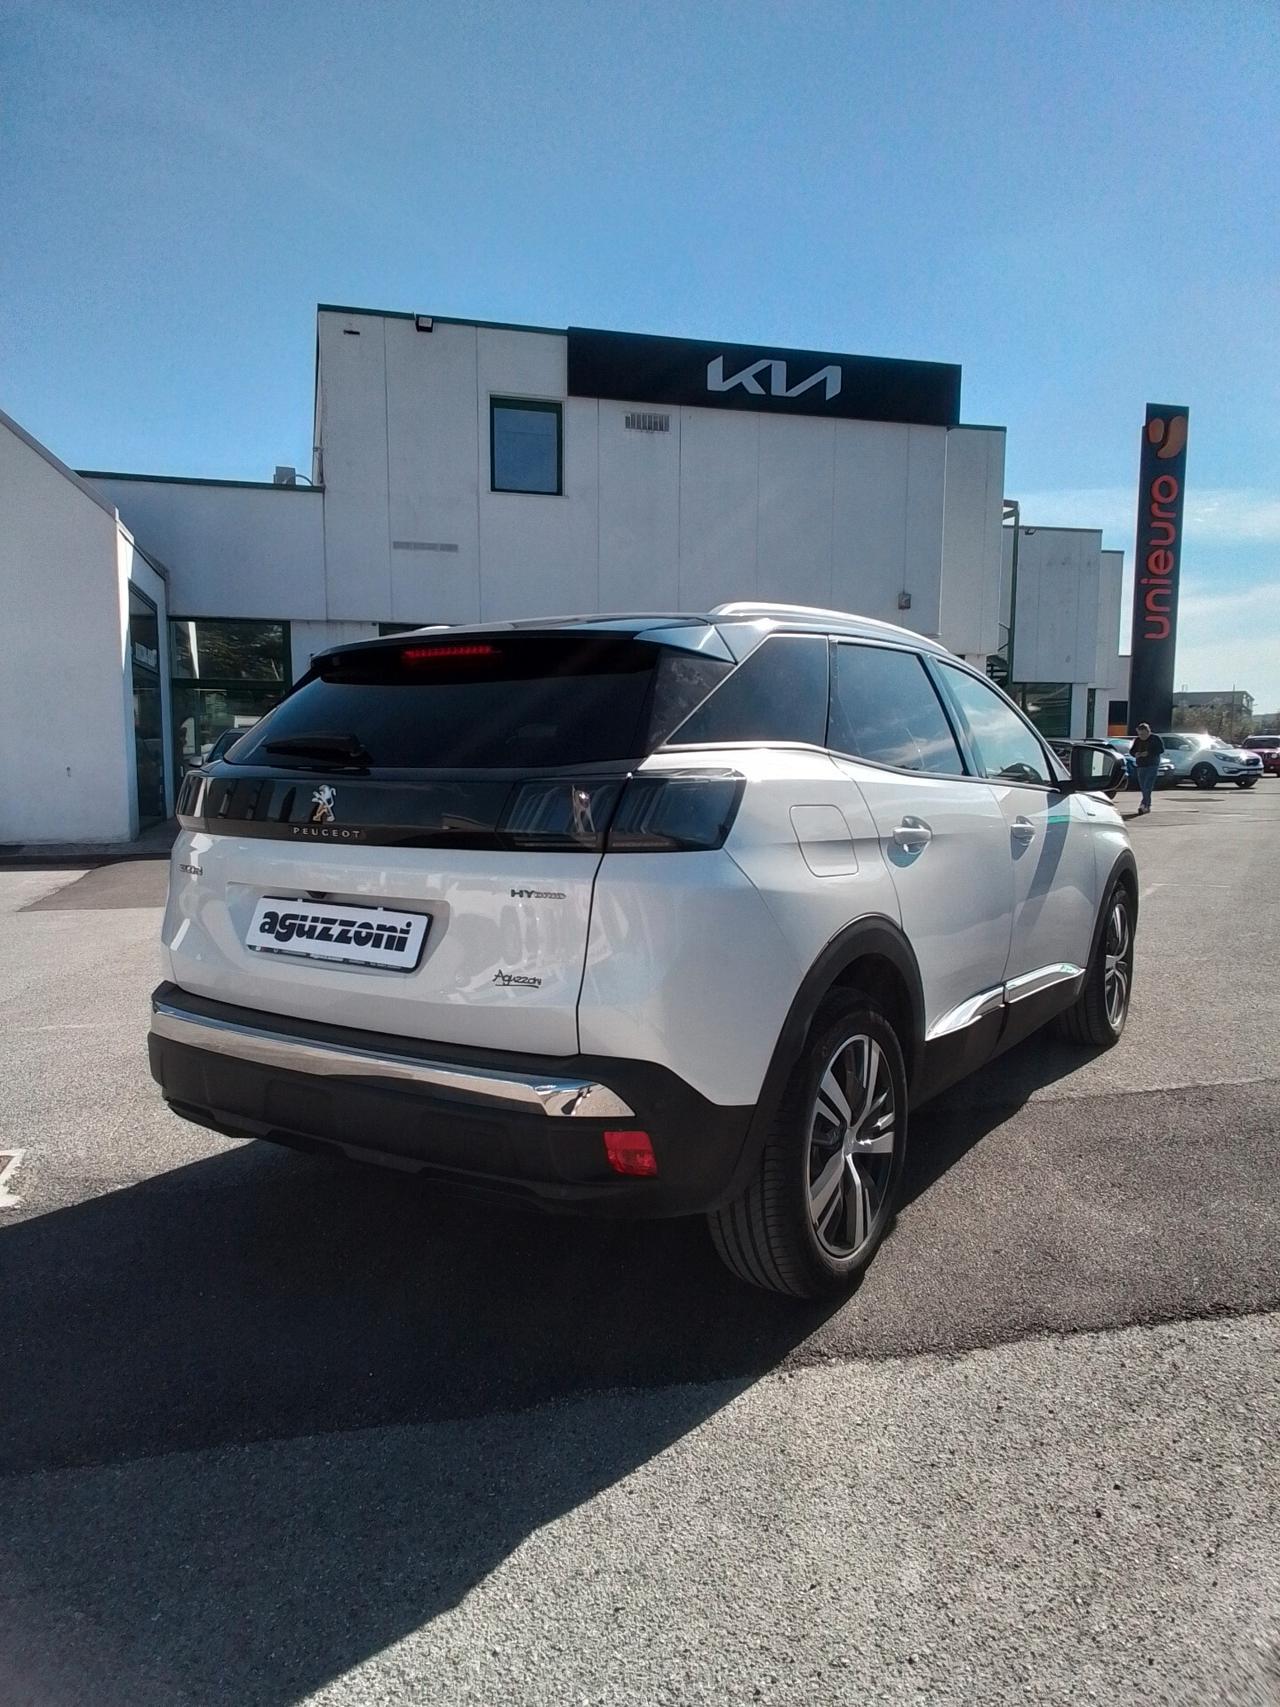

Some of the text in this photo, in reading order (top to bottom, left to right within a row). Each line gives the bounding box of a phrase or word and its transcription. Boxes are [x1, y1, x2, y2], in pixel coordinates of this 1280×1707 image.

[707, 355, 842, 400] KIA
[1140, 474, 1179, 640] unieuro
[292, 826, 361, 839] PEUGEOT
[259, 910, 412, 953] aguzzoni
